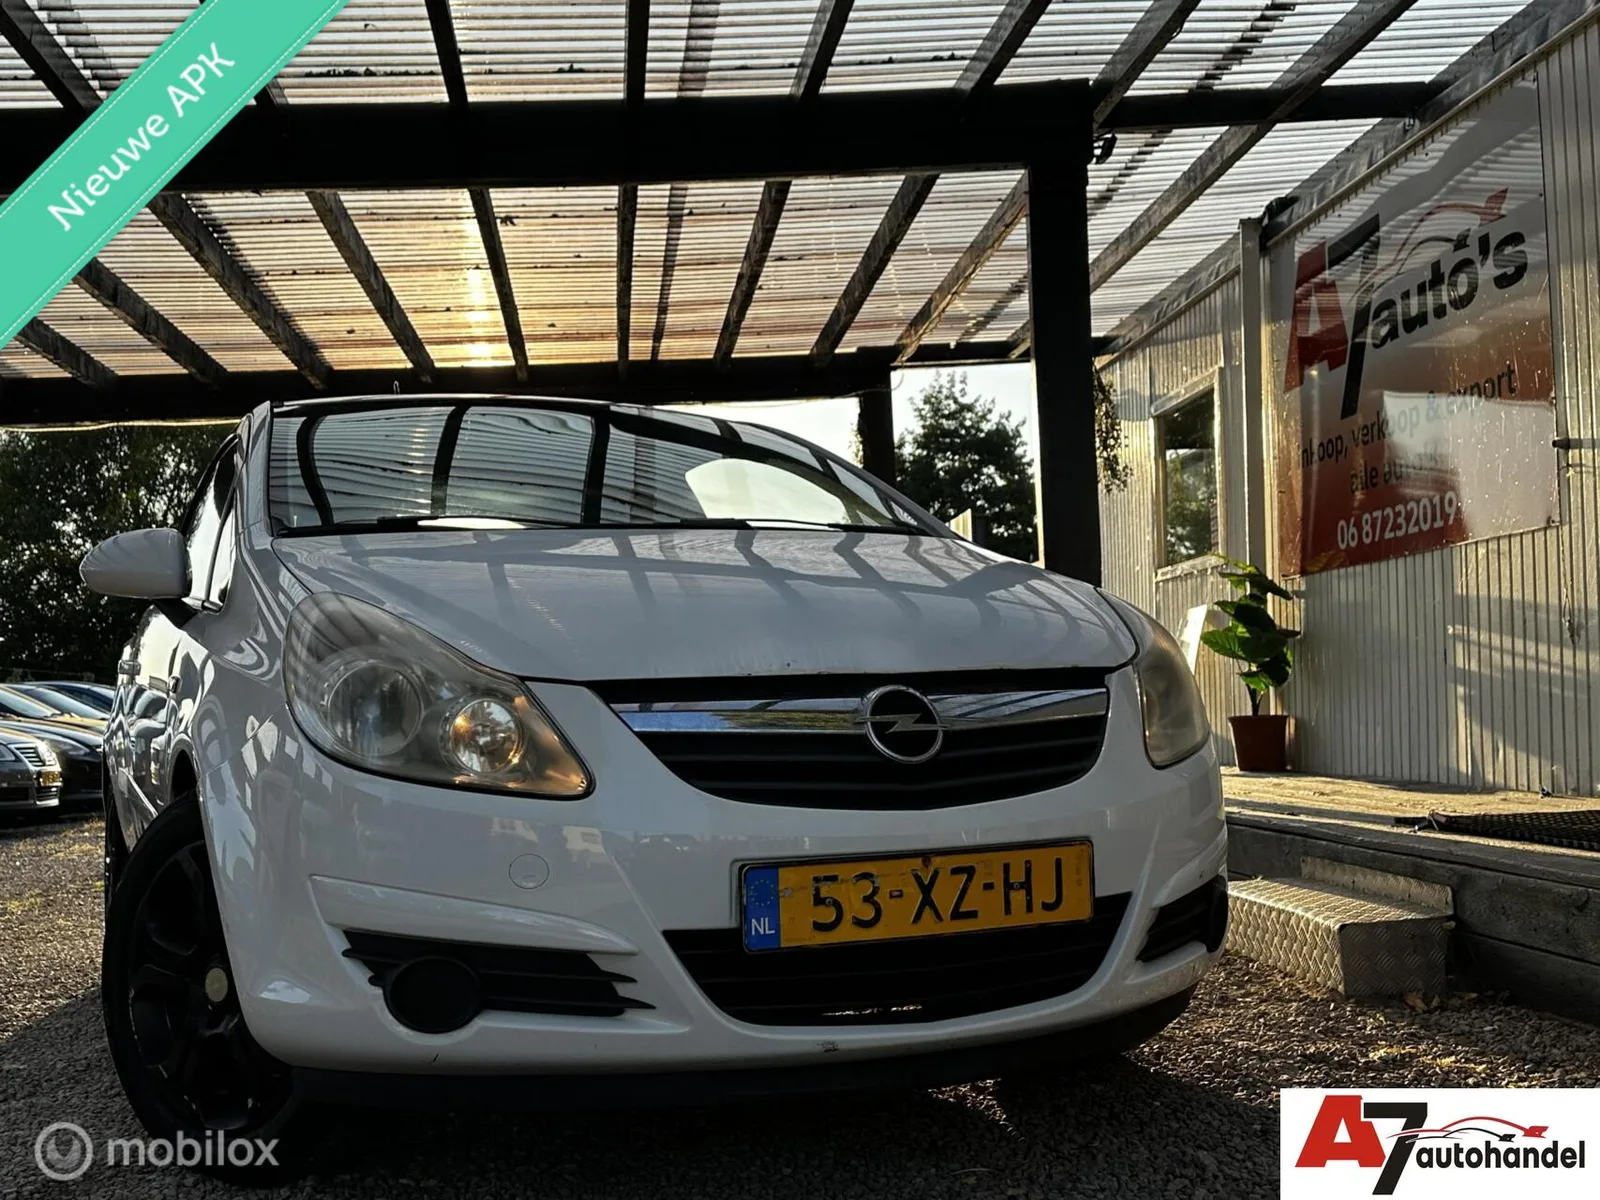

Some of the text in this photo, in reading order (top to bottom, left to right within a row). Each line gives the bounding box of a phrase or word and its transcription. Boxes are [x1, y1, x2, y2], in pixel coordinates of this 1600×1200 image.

[1284, 213, 1529, 421] A7 auto's
[1297, 433, 1349, 469] nkoop,
[1337, 492, 1458, 551] 06 87232019
[811, 857, 1064, 933] 53-XZ-HJ
[750, 917, 776, 937] NL
